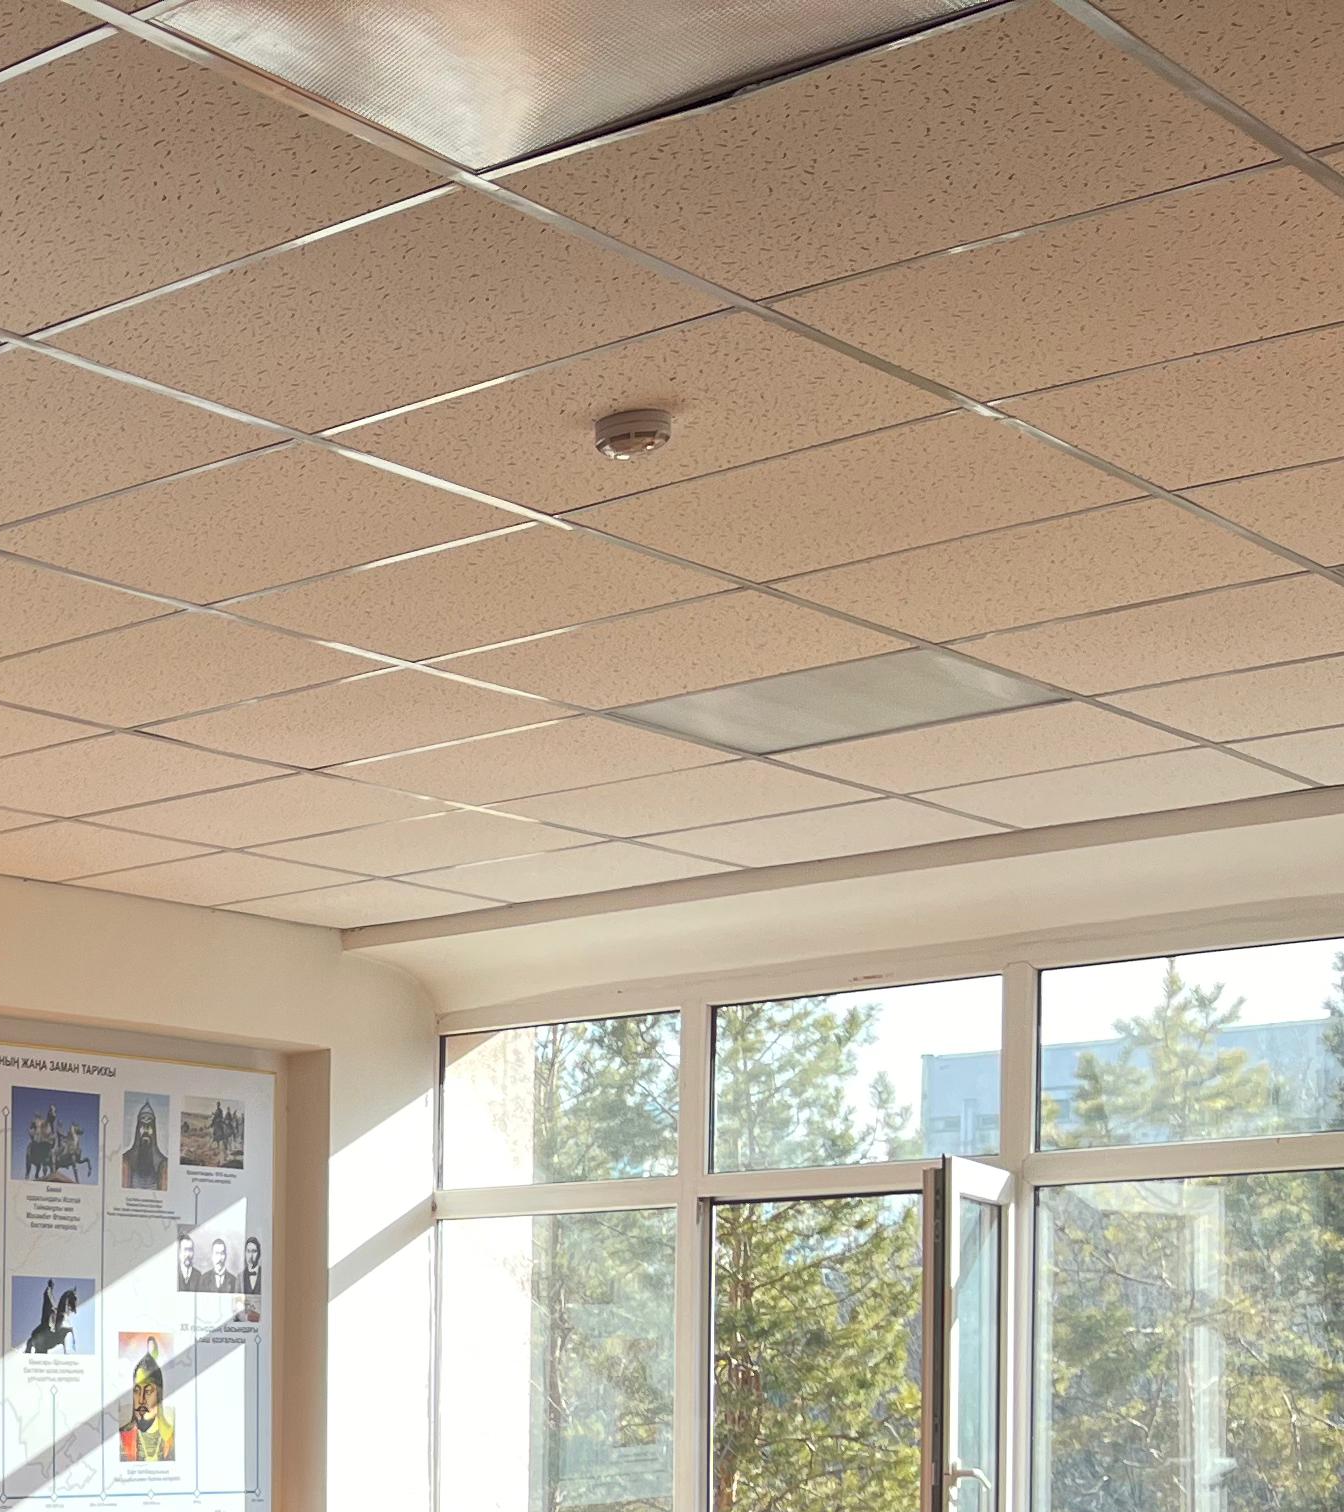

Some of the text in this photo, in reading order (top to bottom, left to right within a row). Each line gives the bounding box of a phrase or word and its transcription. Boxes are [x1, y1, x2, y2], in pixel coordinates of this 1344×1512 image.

[21, 1057, 47, 1072] ЖАҢА
[49, 1060, 80, 1074] ЗАМАН
[81, 1063, 117, 1078] ТАРИХЫ
